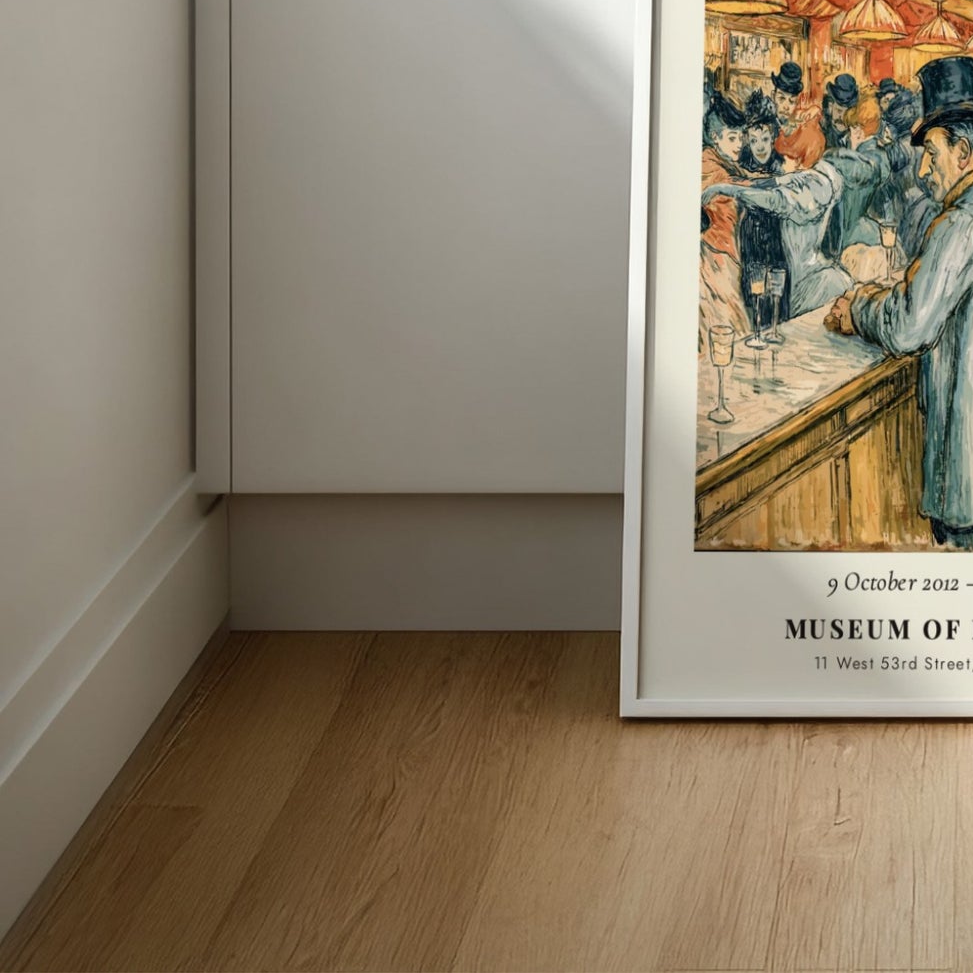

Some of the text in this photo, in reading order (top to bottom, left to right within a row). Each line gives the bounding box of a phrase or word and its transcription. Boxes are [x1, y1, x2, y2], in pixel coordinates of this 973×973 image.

[826, 577, 839, 598] 9
[844, 570, 918, 592] October
[922, 578, 959, 592] 2012
[784, 618, 911, 641] MUSEUM
[922, 618, 961, 641] OF
[814, 656, 828, 671] 11
[836, 656, 875, 671] West
[880, 655, 918, 671] 53rd
